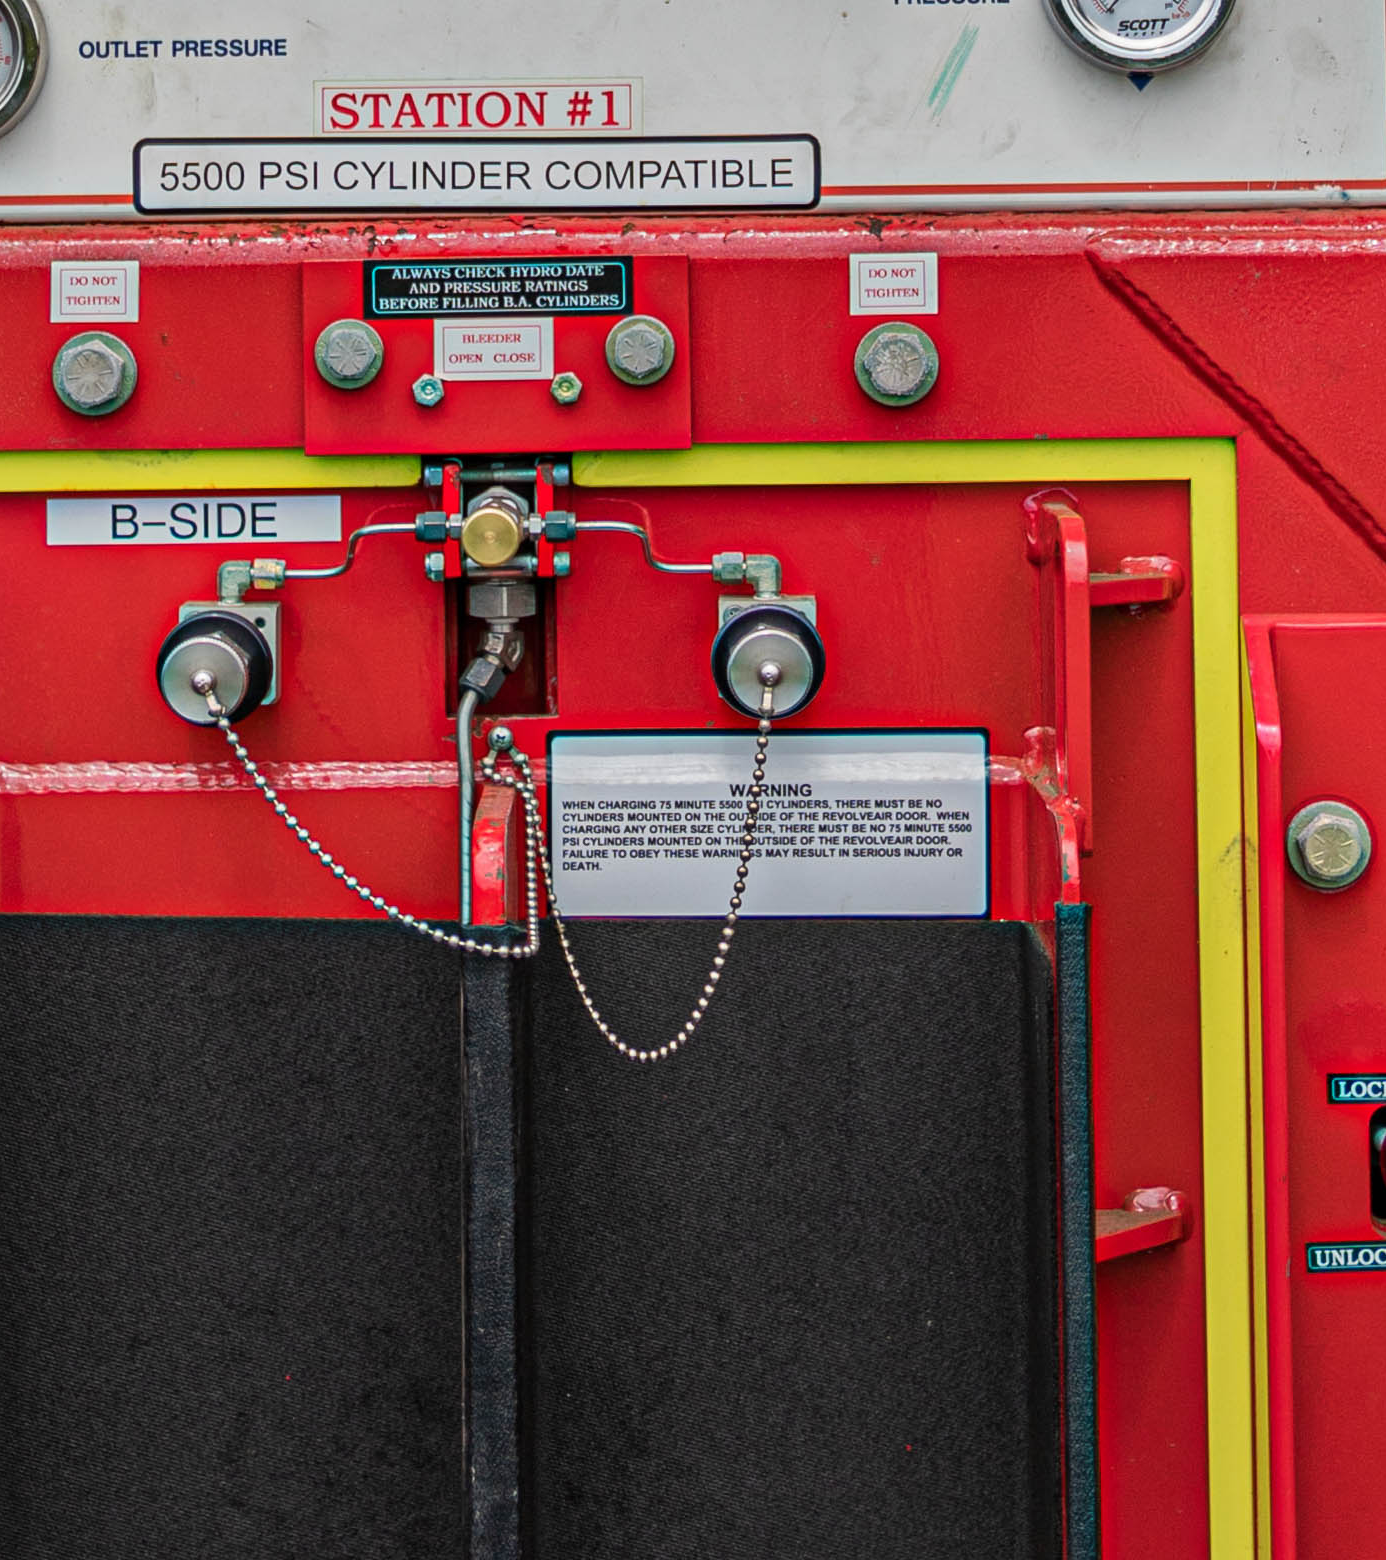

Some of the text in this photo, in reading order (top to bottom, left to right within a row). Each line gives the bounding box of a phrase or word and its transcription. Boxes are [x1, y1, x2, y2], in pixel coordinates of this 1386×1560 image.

[1117, 18, 1170, 32] SCOTT
[79, 39, 287, 58] OUTLET PRESSURE
[330, 89, 619, 130] STATION #1
[160, 158, 794, 192] 5500 PSI CYLINDER COMPATIBLE
[392, 265, 605, 280] ALWAYS CHECK HYDRO DATE
[869, 268, 916, 278] DO NOT
[70, 276, 117, 286] DO NOT
[409, 280, 588, 294] AND PRESSURE RATINGS
[865, 288, 919, 298] TIGHTEN
[66, 296, 120, 305] TIGHTEN
[379, 294, 620, 310] BEFORE FILLING B.A. CYLINDERS
[463, 334, 521, 343] BLEEDER
[449, 353, 535, 363] OPEN CLOSE
[112, 502, 277, 539] B-SIDE
[562, 801, 594, 809] WHEN
[598, 801, 656, 809] CHARGING
[660, 801, 671, 809] 75
[675, 800, 715, 809] MINUTE
[719, 801, 743, 809] 5500
[767, 800, 831, 809] CYLINDERS,
[835, 800, 871, 808] THERE
[875, 800, 905, 808] MUST
[908, 799, 922, 808] BE
[926, 799, 942, 808] NO
